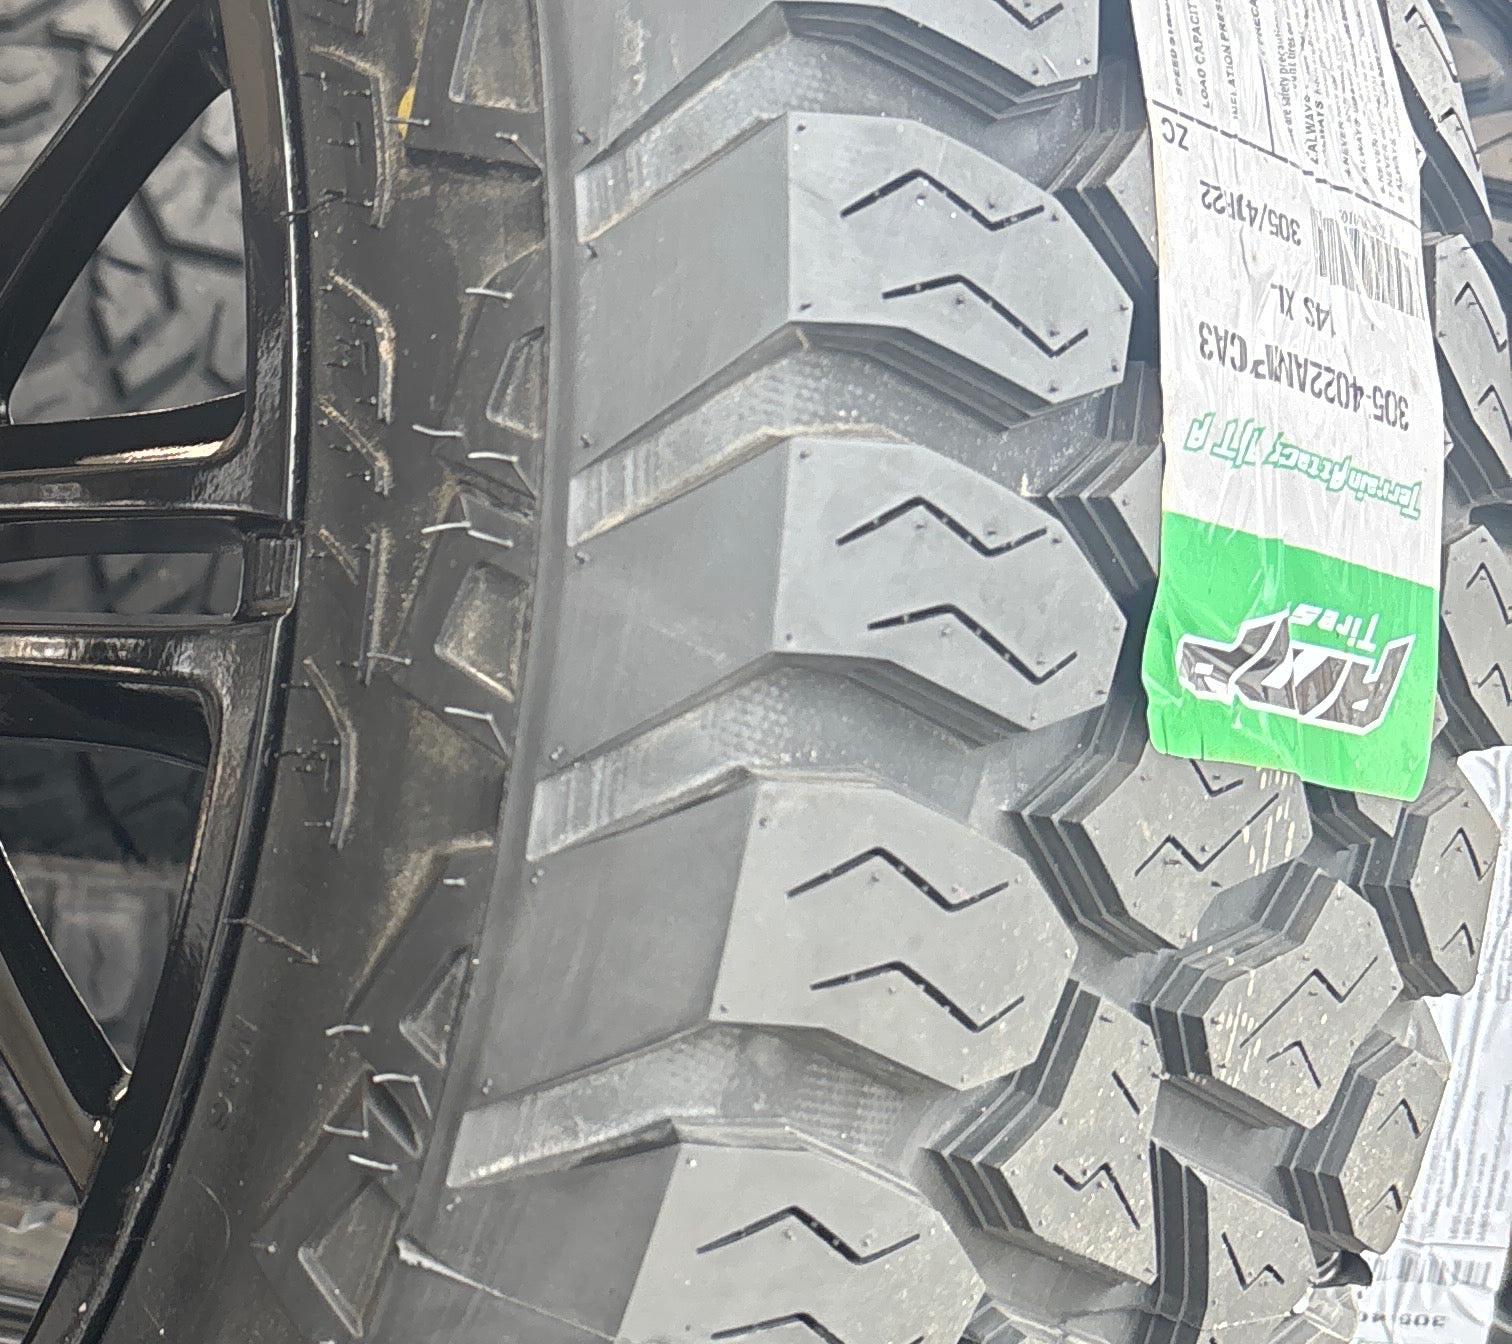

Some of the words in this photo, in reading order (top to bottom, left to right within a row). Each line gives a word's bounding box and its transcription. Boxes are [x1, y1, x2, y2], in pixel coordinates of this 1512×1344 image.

[1195, 63, 1210, 108] LOAD
[1159, 116, 1188, 151] ZC
[1269, 282, 1294, 320] XL
[1284, 601, 1379, 655] Tires
